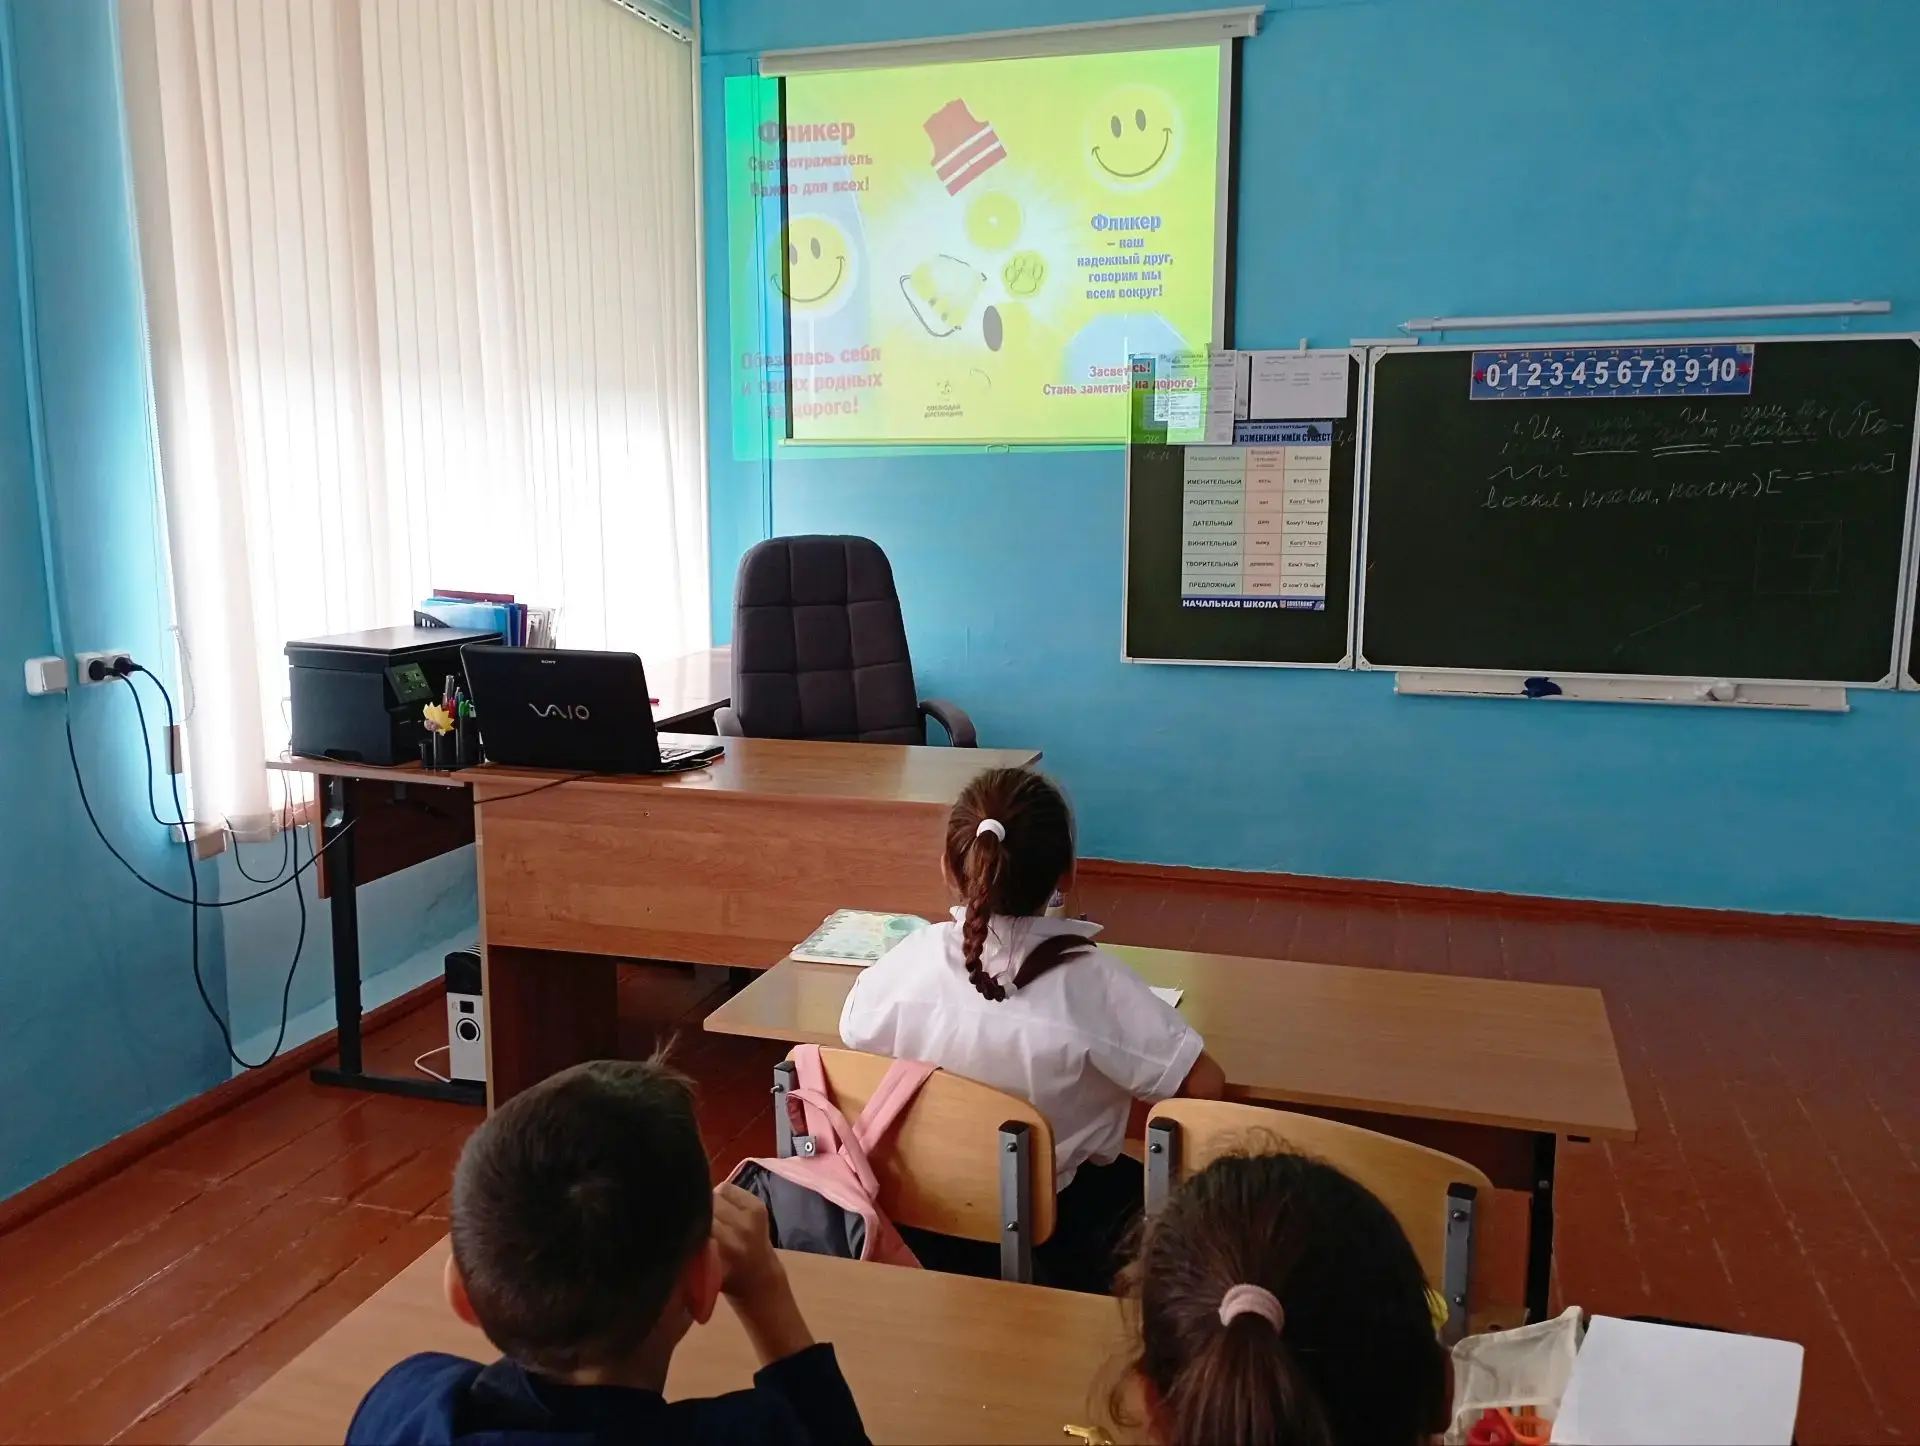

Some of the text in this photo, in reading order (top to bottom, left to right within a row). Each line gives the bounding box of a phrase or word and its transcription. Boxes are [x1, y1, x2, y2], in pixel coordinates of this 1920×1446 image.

[803, 182, 828, 195] для
[833, 176, 869, 192] всех!
[1091, 213, 1162, 232] Фликер
[1119, 238, 1144, 248] наш
[1077, 253, 1174, 267] надежный друг,
[1088, 271, 1162, 284] говорим мы
[1086, 284, 1163, 300] всем вокруг!
[840, 345, 881, 362] себя
[1486, 358, 1736, 387] 0 1 2 3 4 5 6 7 8 9 10
[742, 382, 752, 396] и
[815, 372, 883, 393] родных
[1043, 383, 1077, 396] Стань
[1135, 380, 1149, 389] на
[1240, 433, 1280, 442] ИЗМЕНЕНИЕ
[1182, 600, 1240, 608] НАЧАЛЬНАЯ
[1243, 600, 1279, 609] ШКОЛА
[528, 703, 590, 720] VAIO
